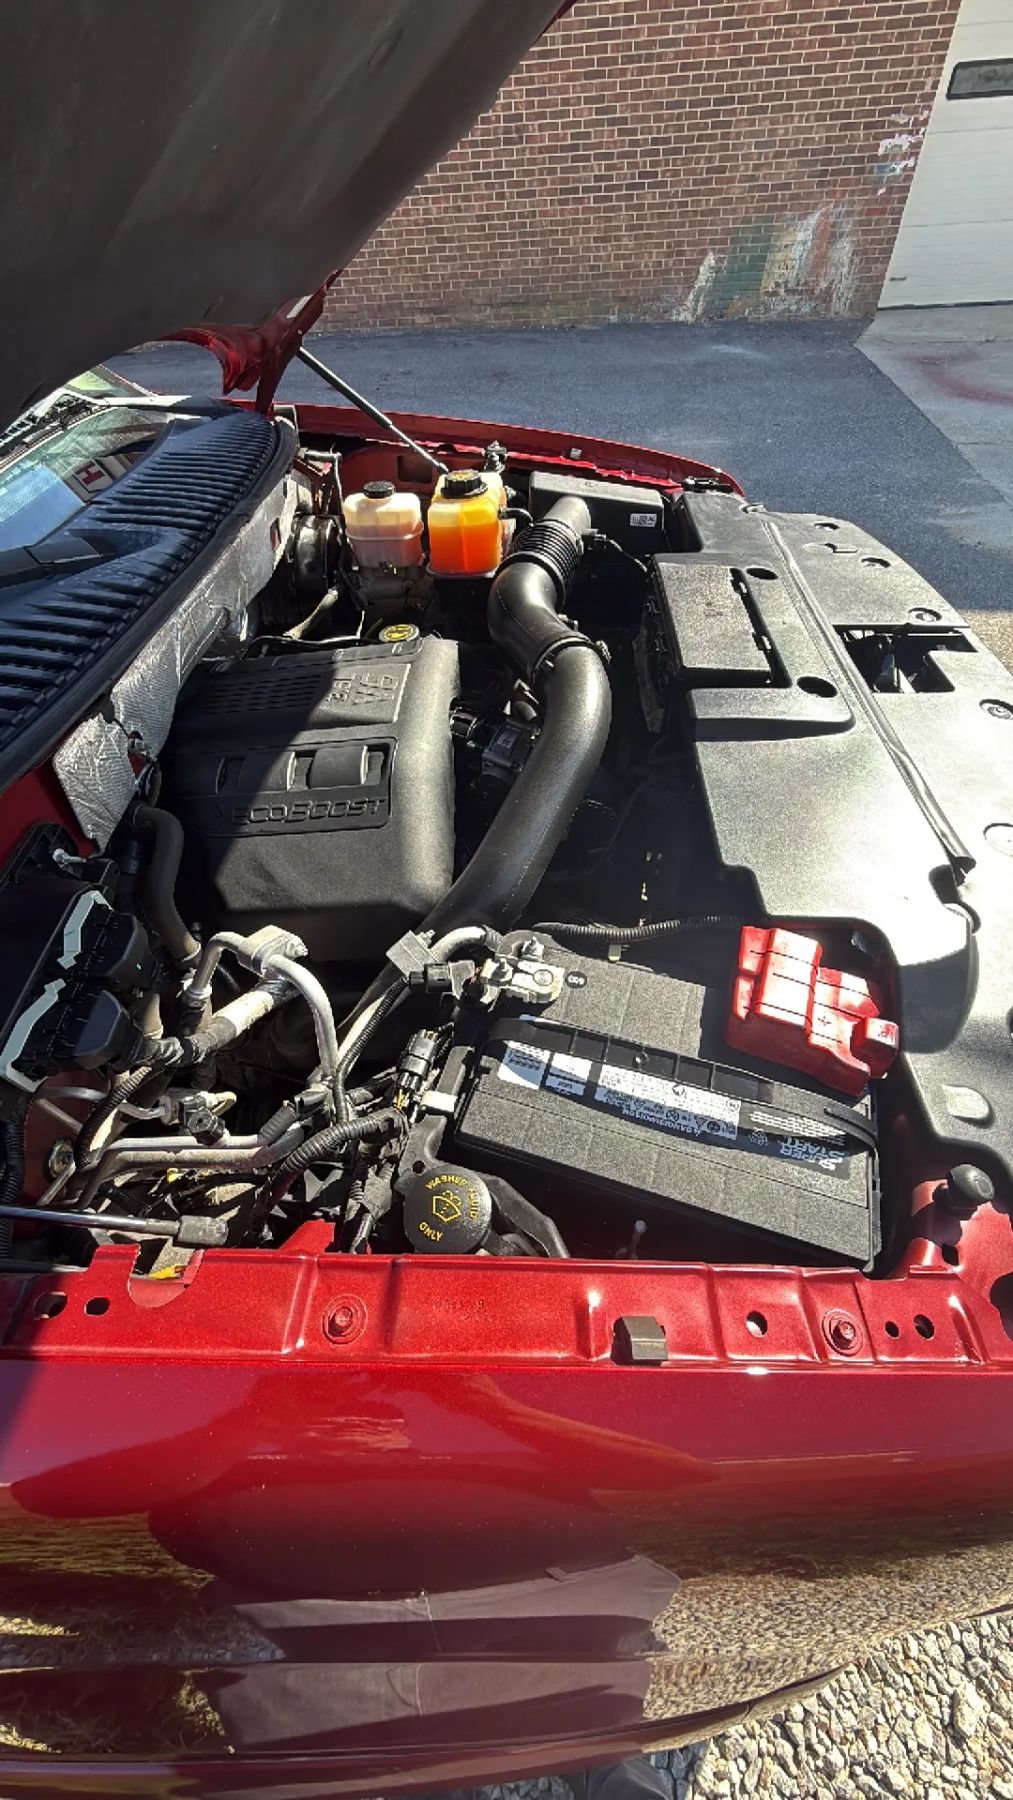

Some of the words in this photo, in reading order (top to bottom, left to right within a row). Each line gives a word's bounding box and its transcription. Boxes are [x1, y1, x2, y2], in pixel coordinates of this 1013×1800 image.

[353, 673, 398, 705] V6
[780, 1136, 845, 1160] START
[780, 1143, 843, 1171] SUPER
[425, 1175, 467, 1190] WASHER
[467, 1187, 480, 1220] FLUID
[419, 1221, 443, 1241] ONLY
